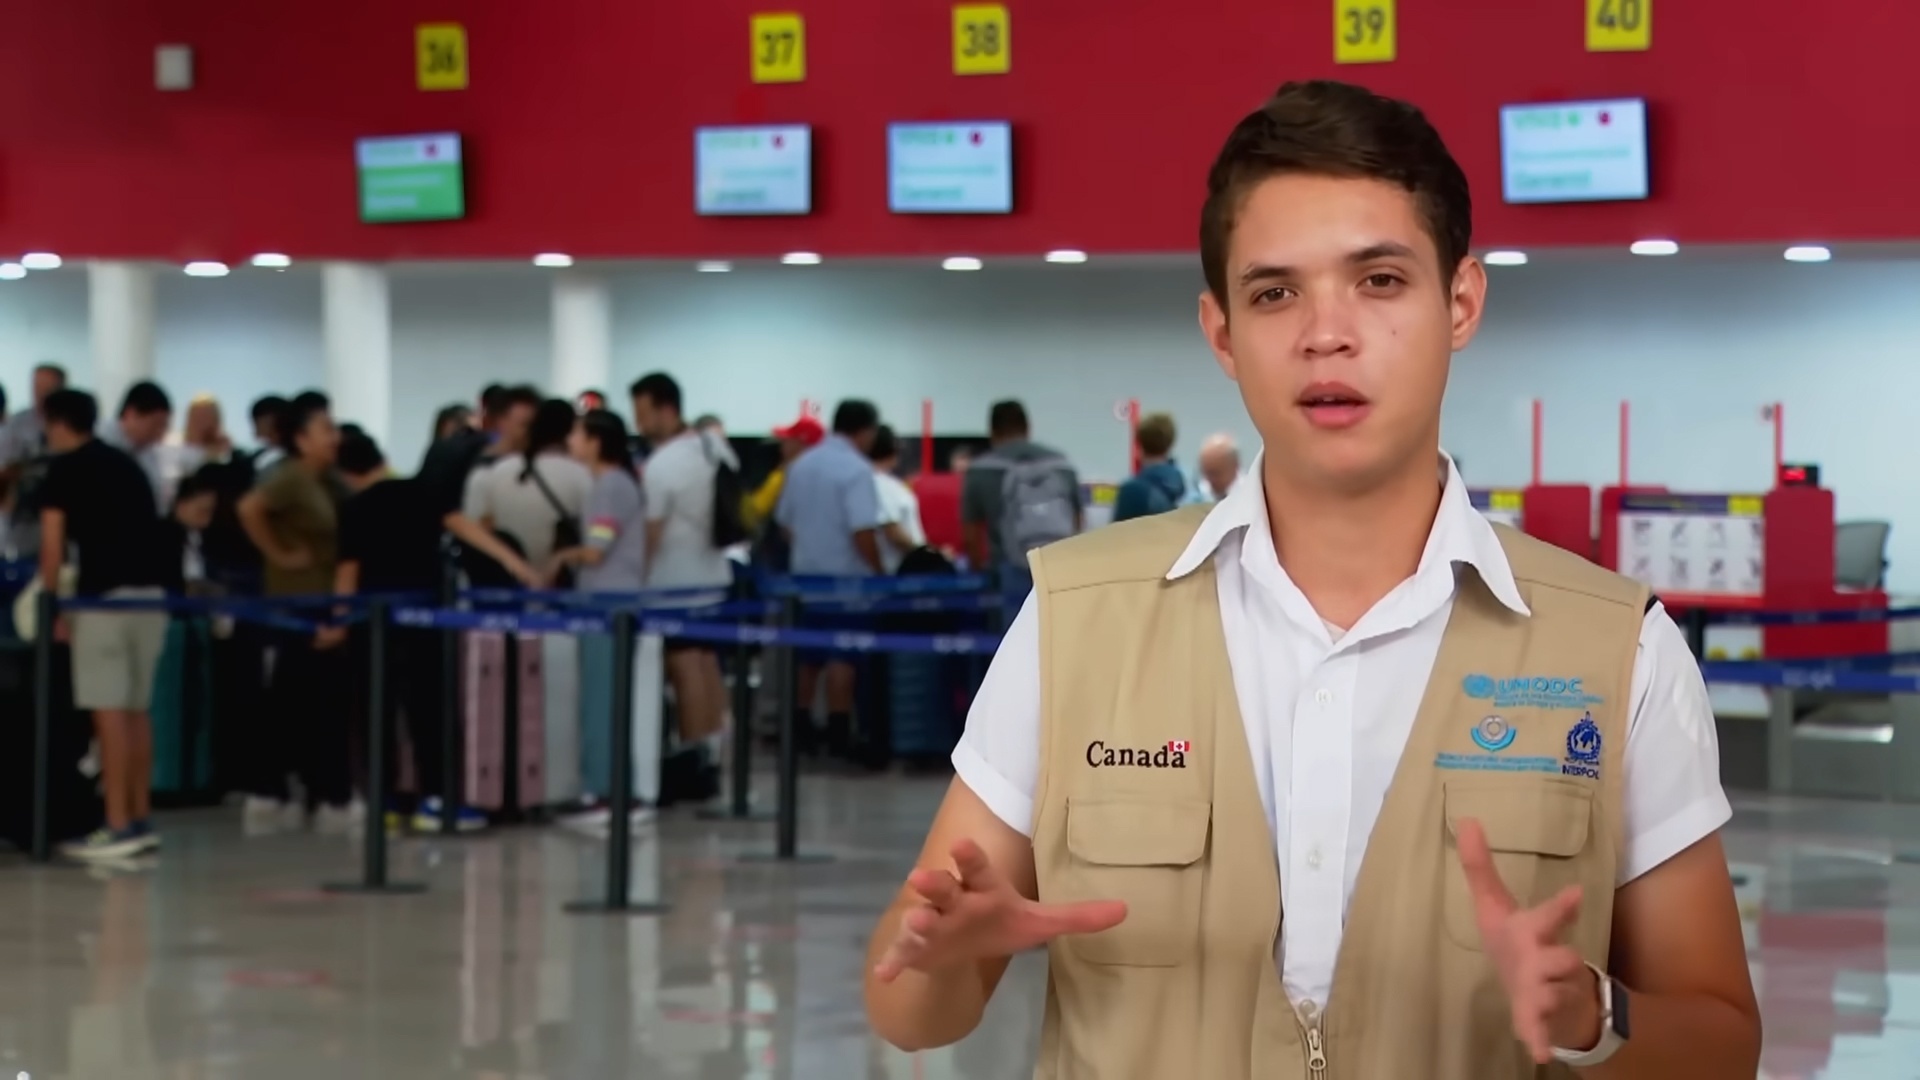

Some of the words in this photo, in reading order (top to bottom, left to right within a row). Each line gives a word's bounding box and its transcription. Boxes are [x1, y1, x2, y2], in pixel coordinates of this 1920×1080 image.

[1343, 8, 1385, 46] 39
[1596, 0, 1640, 32] 40
[760, 31, 795, 67] 37
[962, 21, 999, 57] 38
[1498, 677, 1583, 694] UNODC
[1086, 740, 1187, 768] Canada
